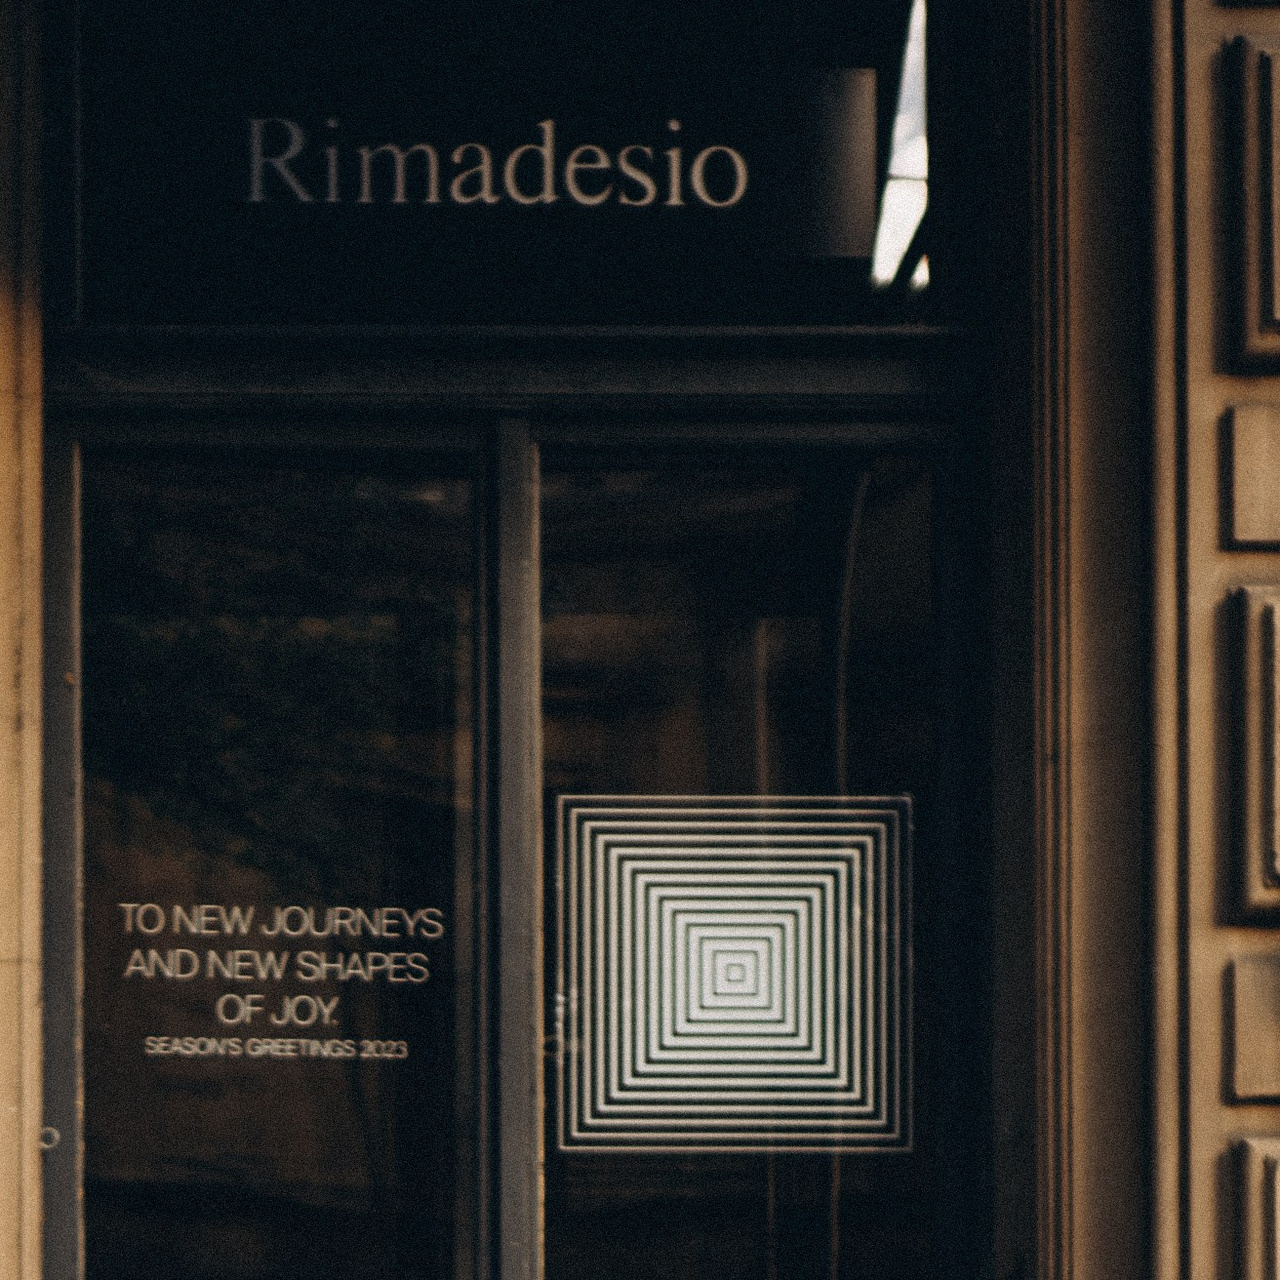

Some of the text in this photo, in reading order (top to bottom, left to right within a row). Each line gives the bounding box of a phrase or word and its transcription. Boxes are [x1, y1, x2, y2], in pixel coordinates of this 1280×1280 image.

[247, 116, 749, 207] Rimadesio
[119, 903, 444, 939] TO NEW JOURNEYS
[124, 948, 430, 983] AND NEW SHAPES
[216, 994, 340, 1027] OF JOY.
[245, 1037, 356, 1058] GREETINGS
[359, 1040, 408, 1059] 2023
